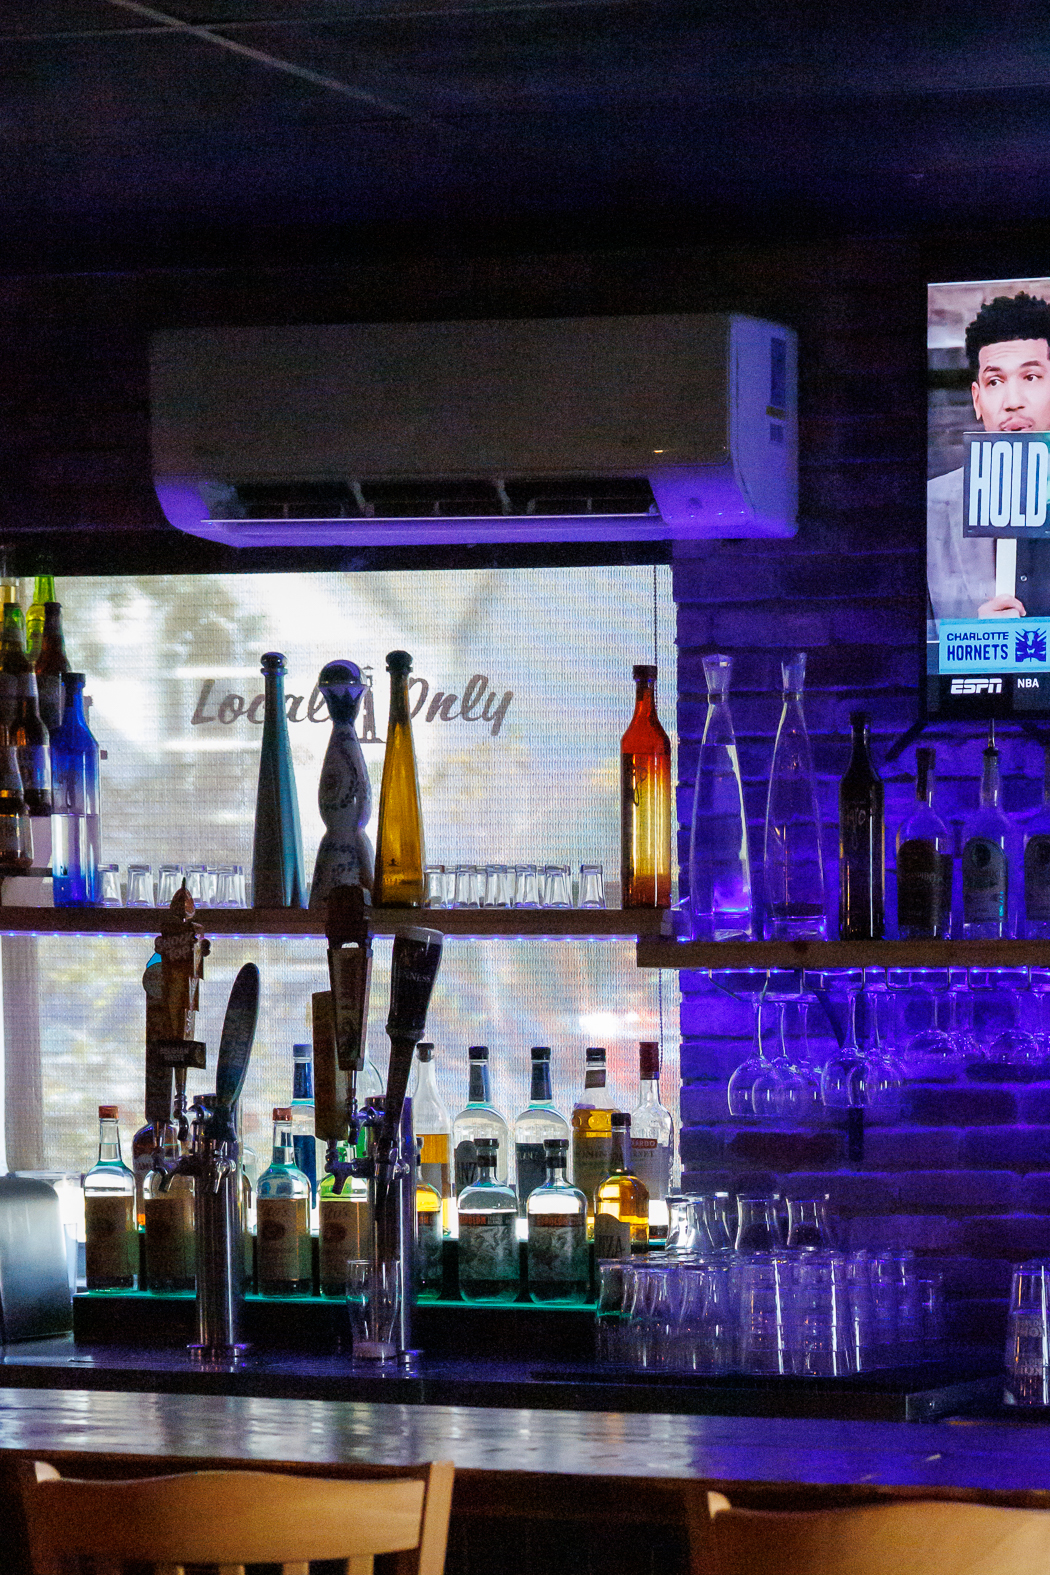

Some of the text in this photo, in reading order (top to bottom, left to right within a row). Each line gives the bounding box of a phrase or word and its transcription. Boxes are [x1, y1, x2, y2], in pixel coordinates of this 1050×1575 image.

[968, 440, 1049, 527] HOLD
[946, 631, 1009, 642] CHARLOTTE
[947, 643, 1009, 661] HORNETS
[950, 678, 1003, 694] ESPN
[1017, 678, 1040, 688] NBA
